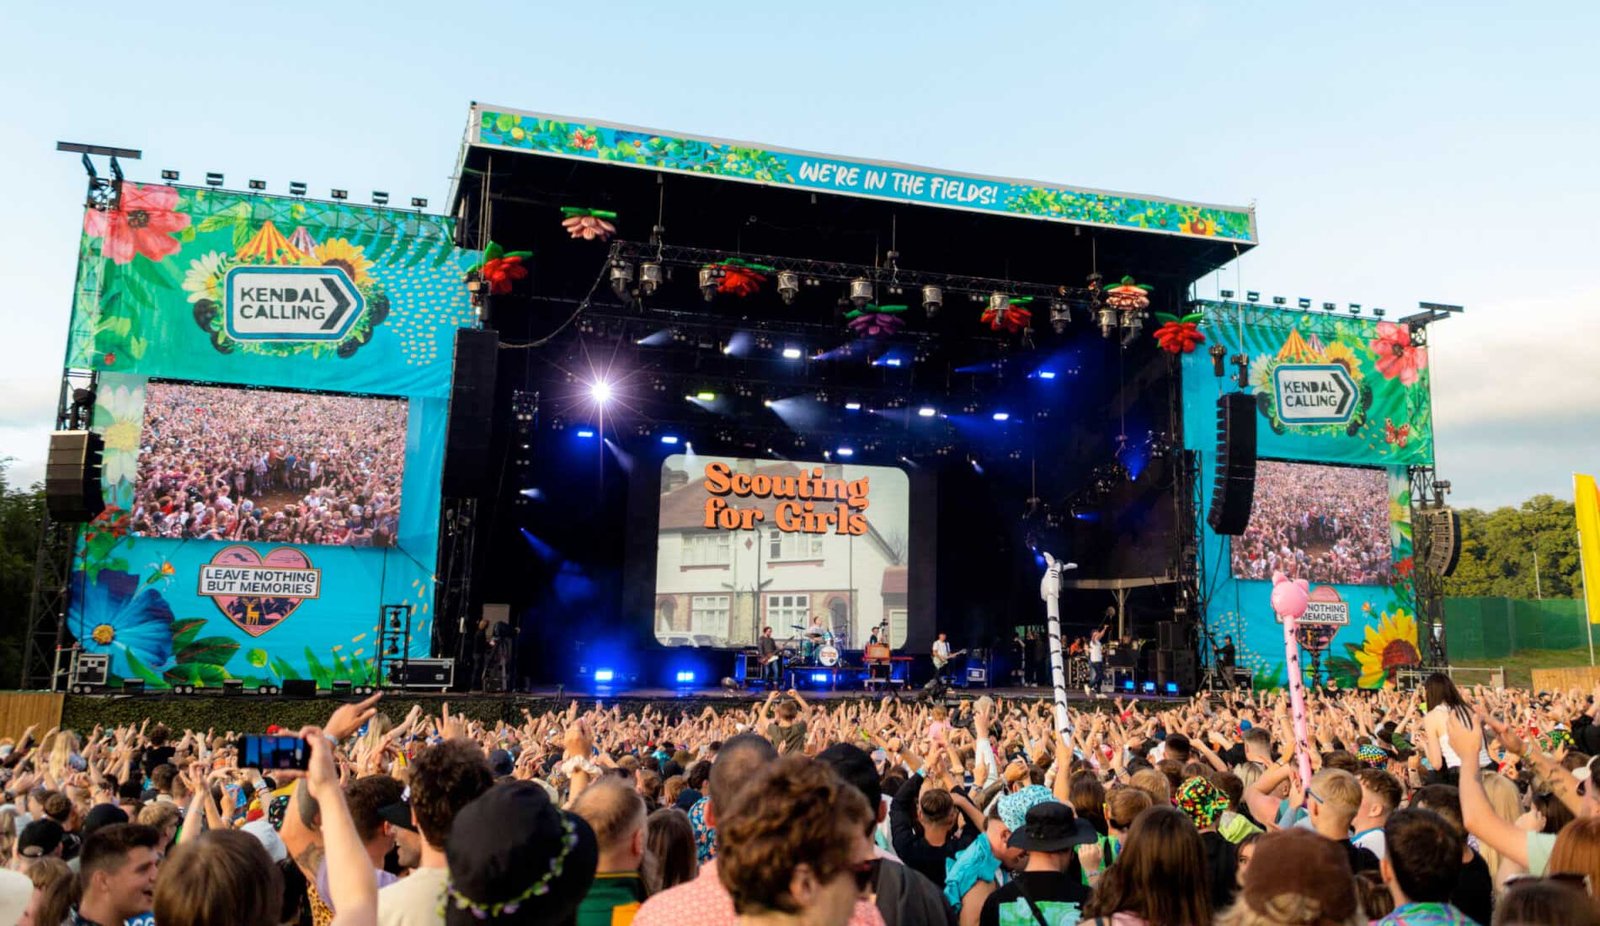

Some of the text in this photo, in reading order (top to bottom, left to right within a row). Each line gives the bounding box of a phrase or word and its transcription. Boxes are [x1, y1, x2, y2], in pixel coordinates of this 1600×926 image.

[799, 161, 998, 205] WE'RE IN THE FIELDS!
[240, 287, 325, 302] KENDAL
[240, 304, 325, 320] CALLING
[1284, 381, 1336, 393] KENDAL
[1285, 395, 1338, 407] CALLING
[704, 461, 870, 511] Scouting
[703, 496, 868, 535] for Girls
[205, 568, 316, 583] LEAVE NOTHING
[207, 580, 313, 594] BUT MEMORIES
[1307, 603, 1346, 613] NOTHING
[1300, 612, 1345, 622] MEMORIES
